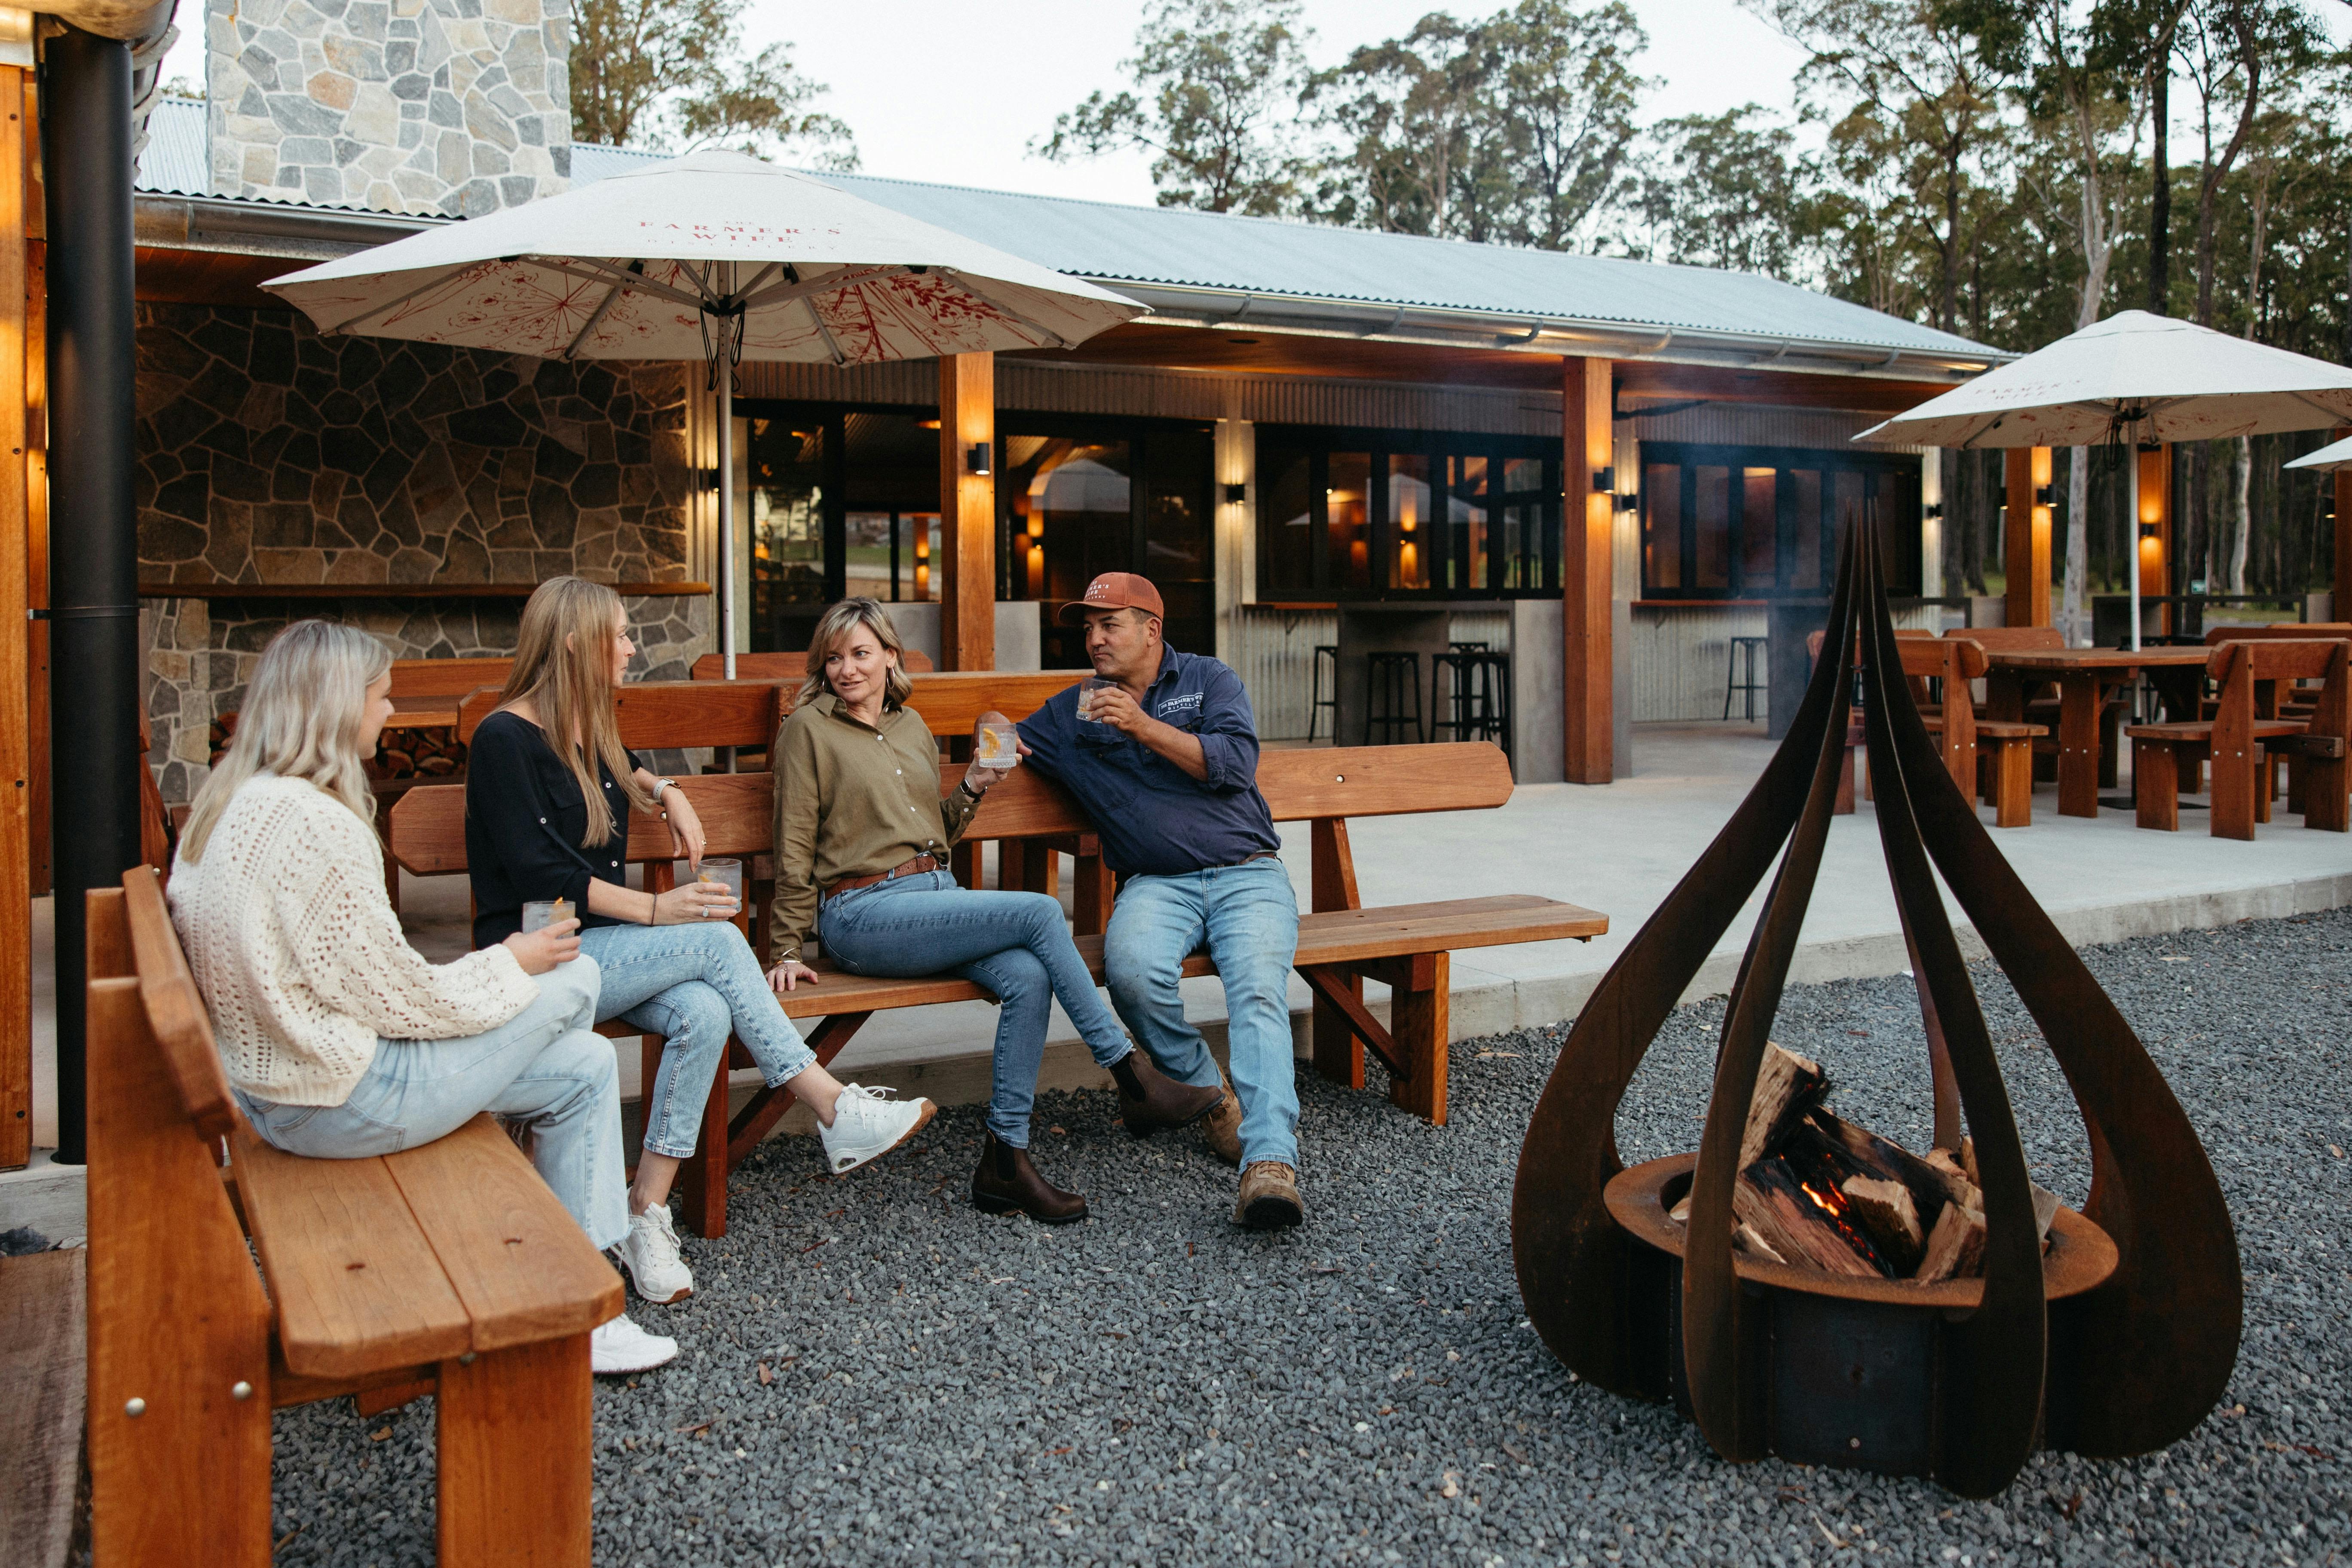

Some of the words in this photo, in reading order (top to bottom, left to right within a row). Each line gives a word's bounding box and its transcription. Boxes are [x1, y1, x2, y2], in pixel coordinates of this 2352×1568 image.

[639, 221, 841, 235] FARMER'S
[692, 233, 793, 242] WIFE
[1168, 697, 1194, 706] FARMER'S
